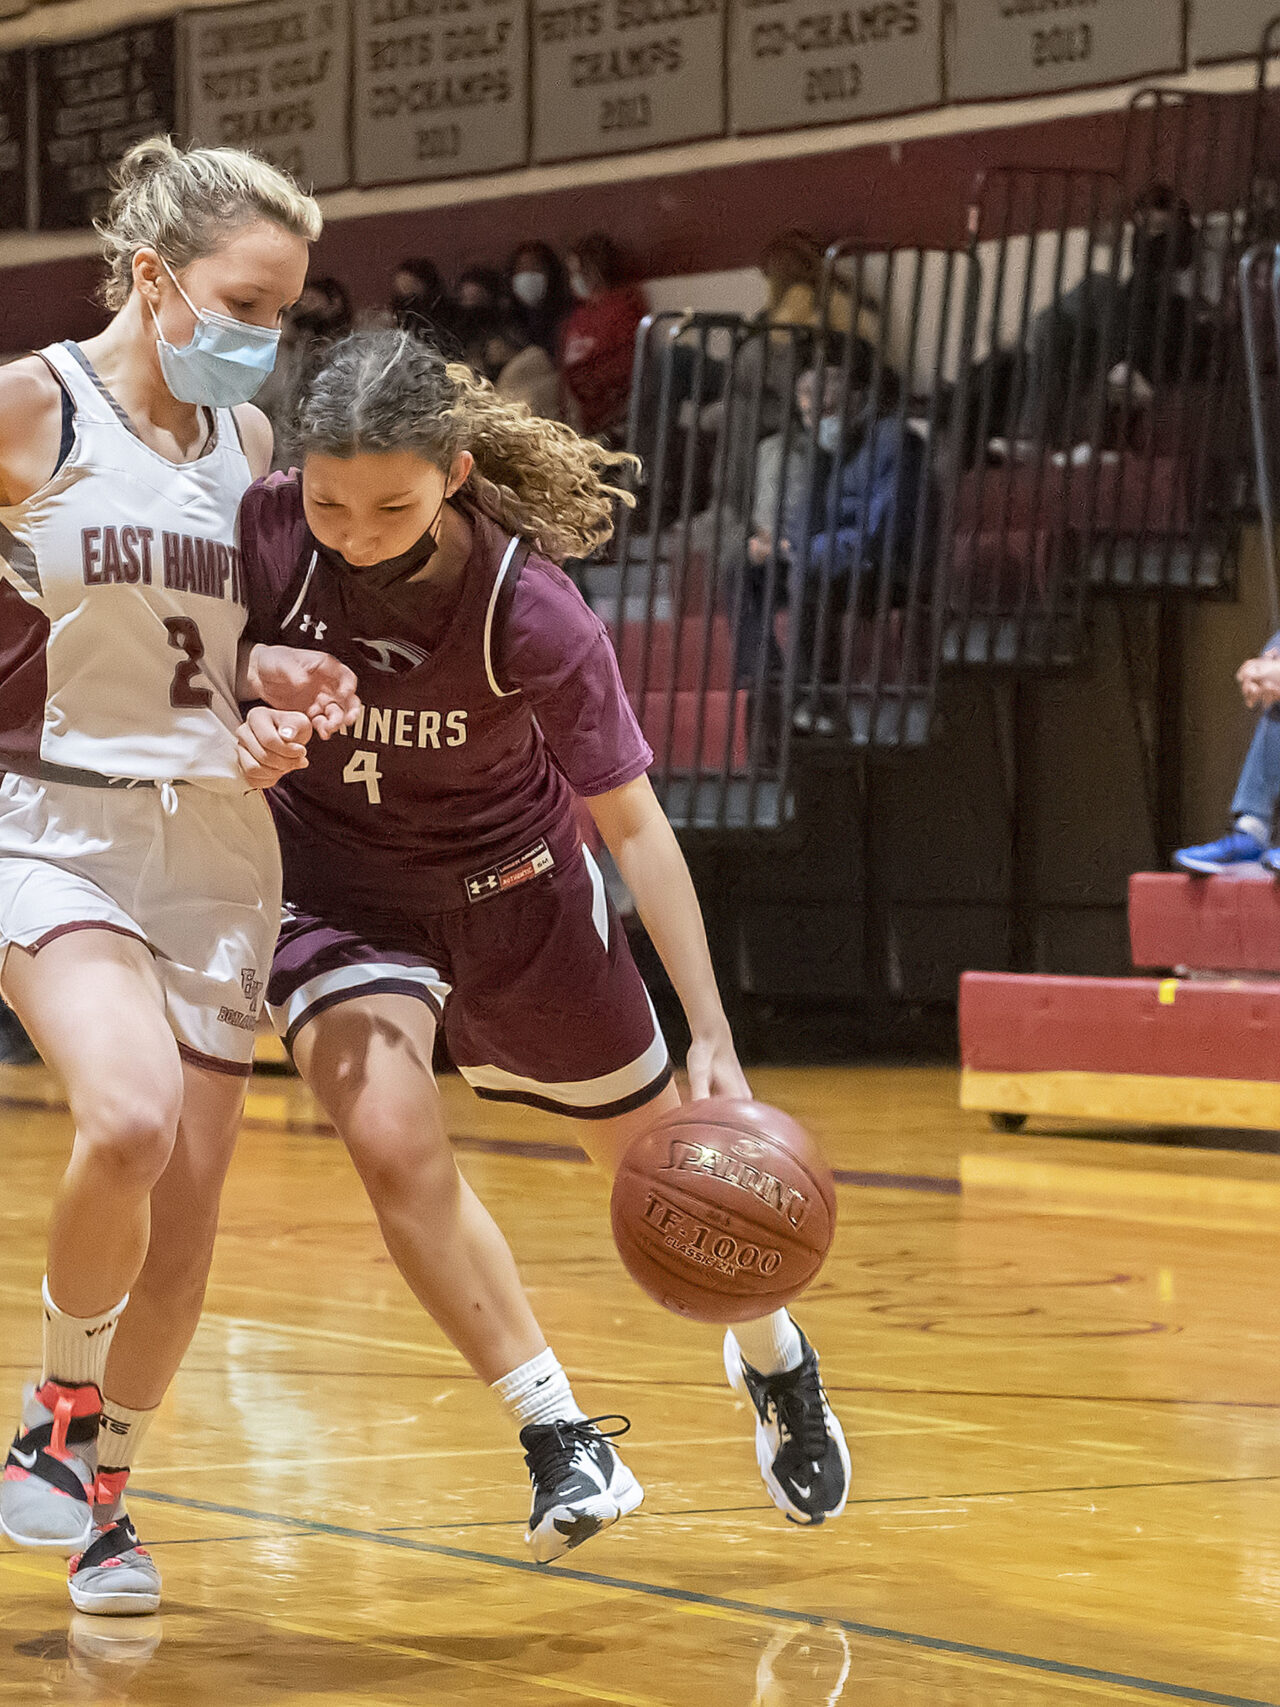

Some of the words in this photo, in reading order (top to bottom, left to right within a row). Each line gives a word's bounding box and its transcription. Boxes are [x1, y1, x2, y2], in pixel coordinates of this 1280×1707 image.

[80, 525, 154, 586] EAST
[163, 616, 213, 709] 2
[342, 750, 383, 805] 4
